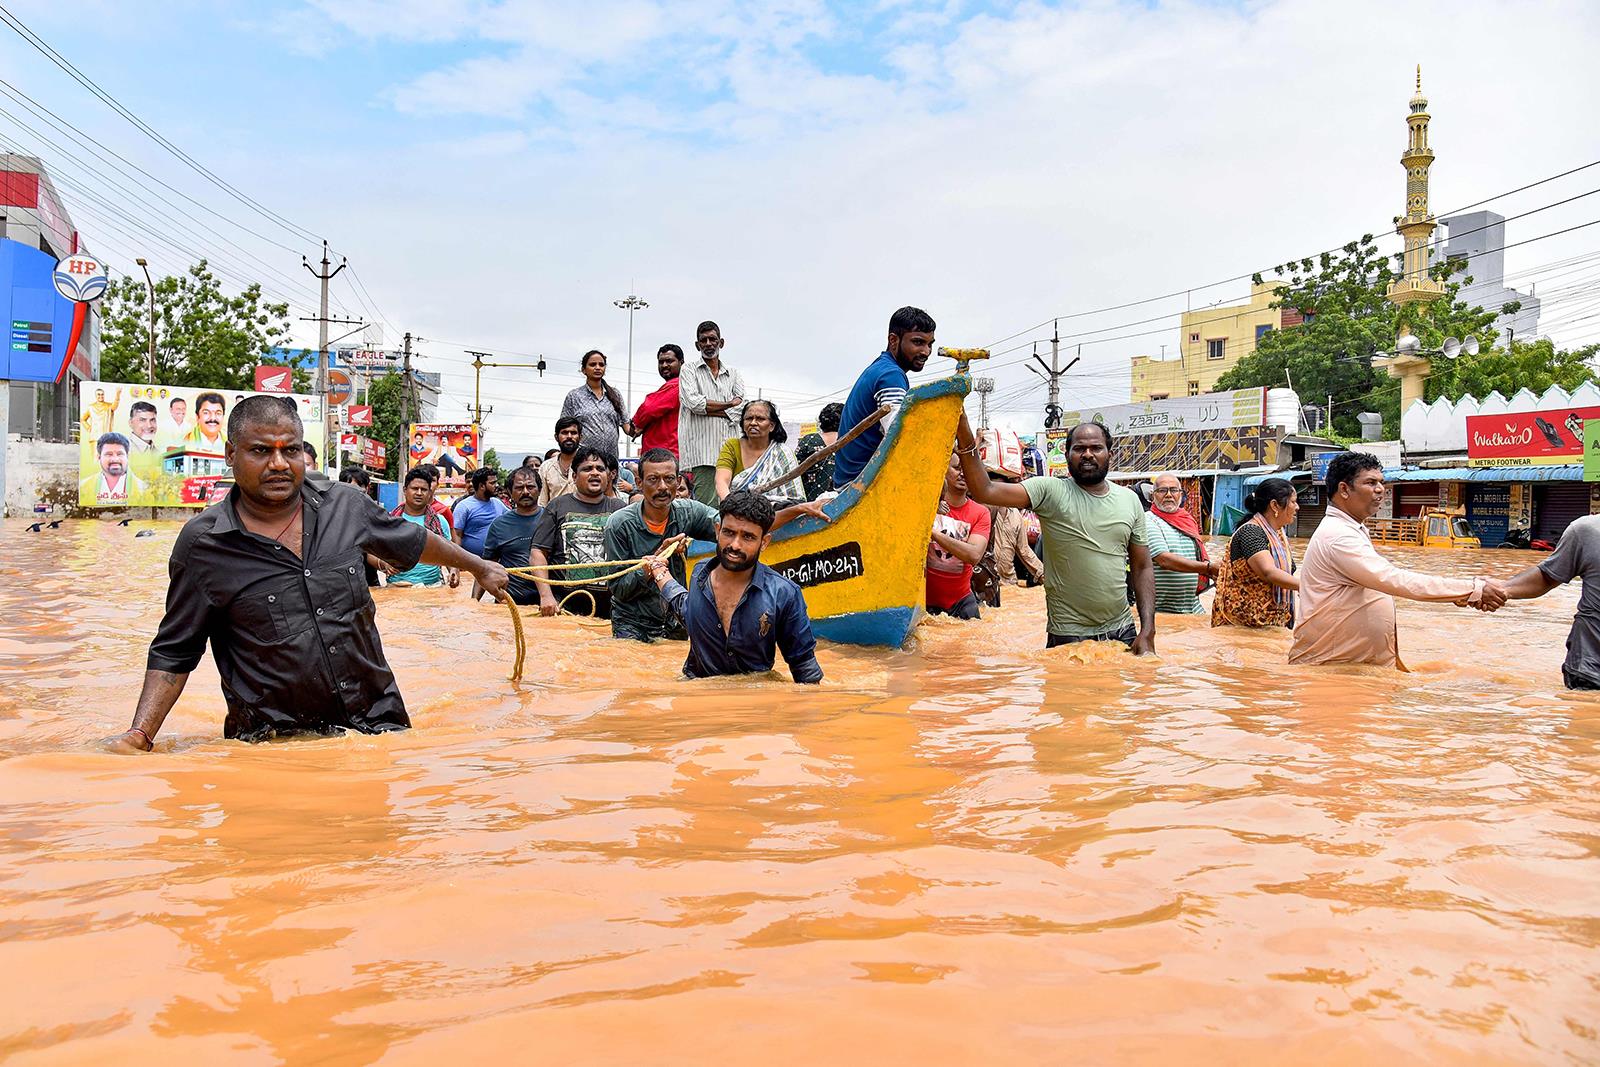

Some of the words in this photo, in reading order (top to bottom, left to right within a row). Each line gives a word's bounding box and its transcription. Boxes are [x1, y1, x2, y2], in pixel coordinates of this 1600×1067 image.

[69, 260, 96, 275] HP
[12, 343, 27, 351] CNG
[356, 351, 385, 360] EAGLE
[1129, 412, 1169, 428] zaara
[1474, 459, 1495, 467] METRO
[1496, 458, 1532, 467] FOOTWEAR
